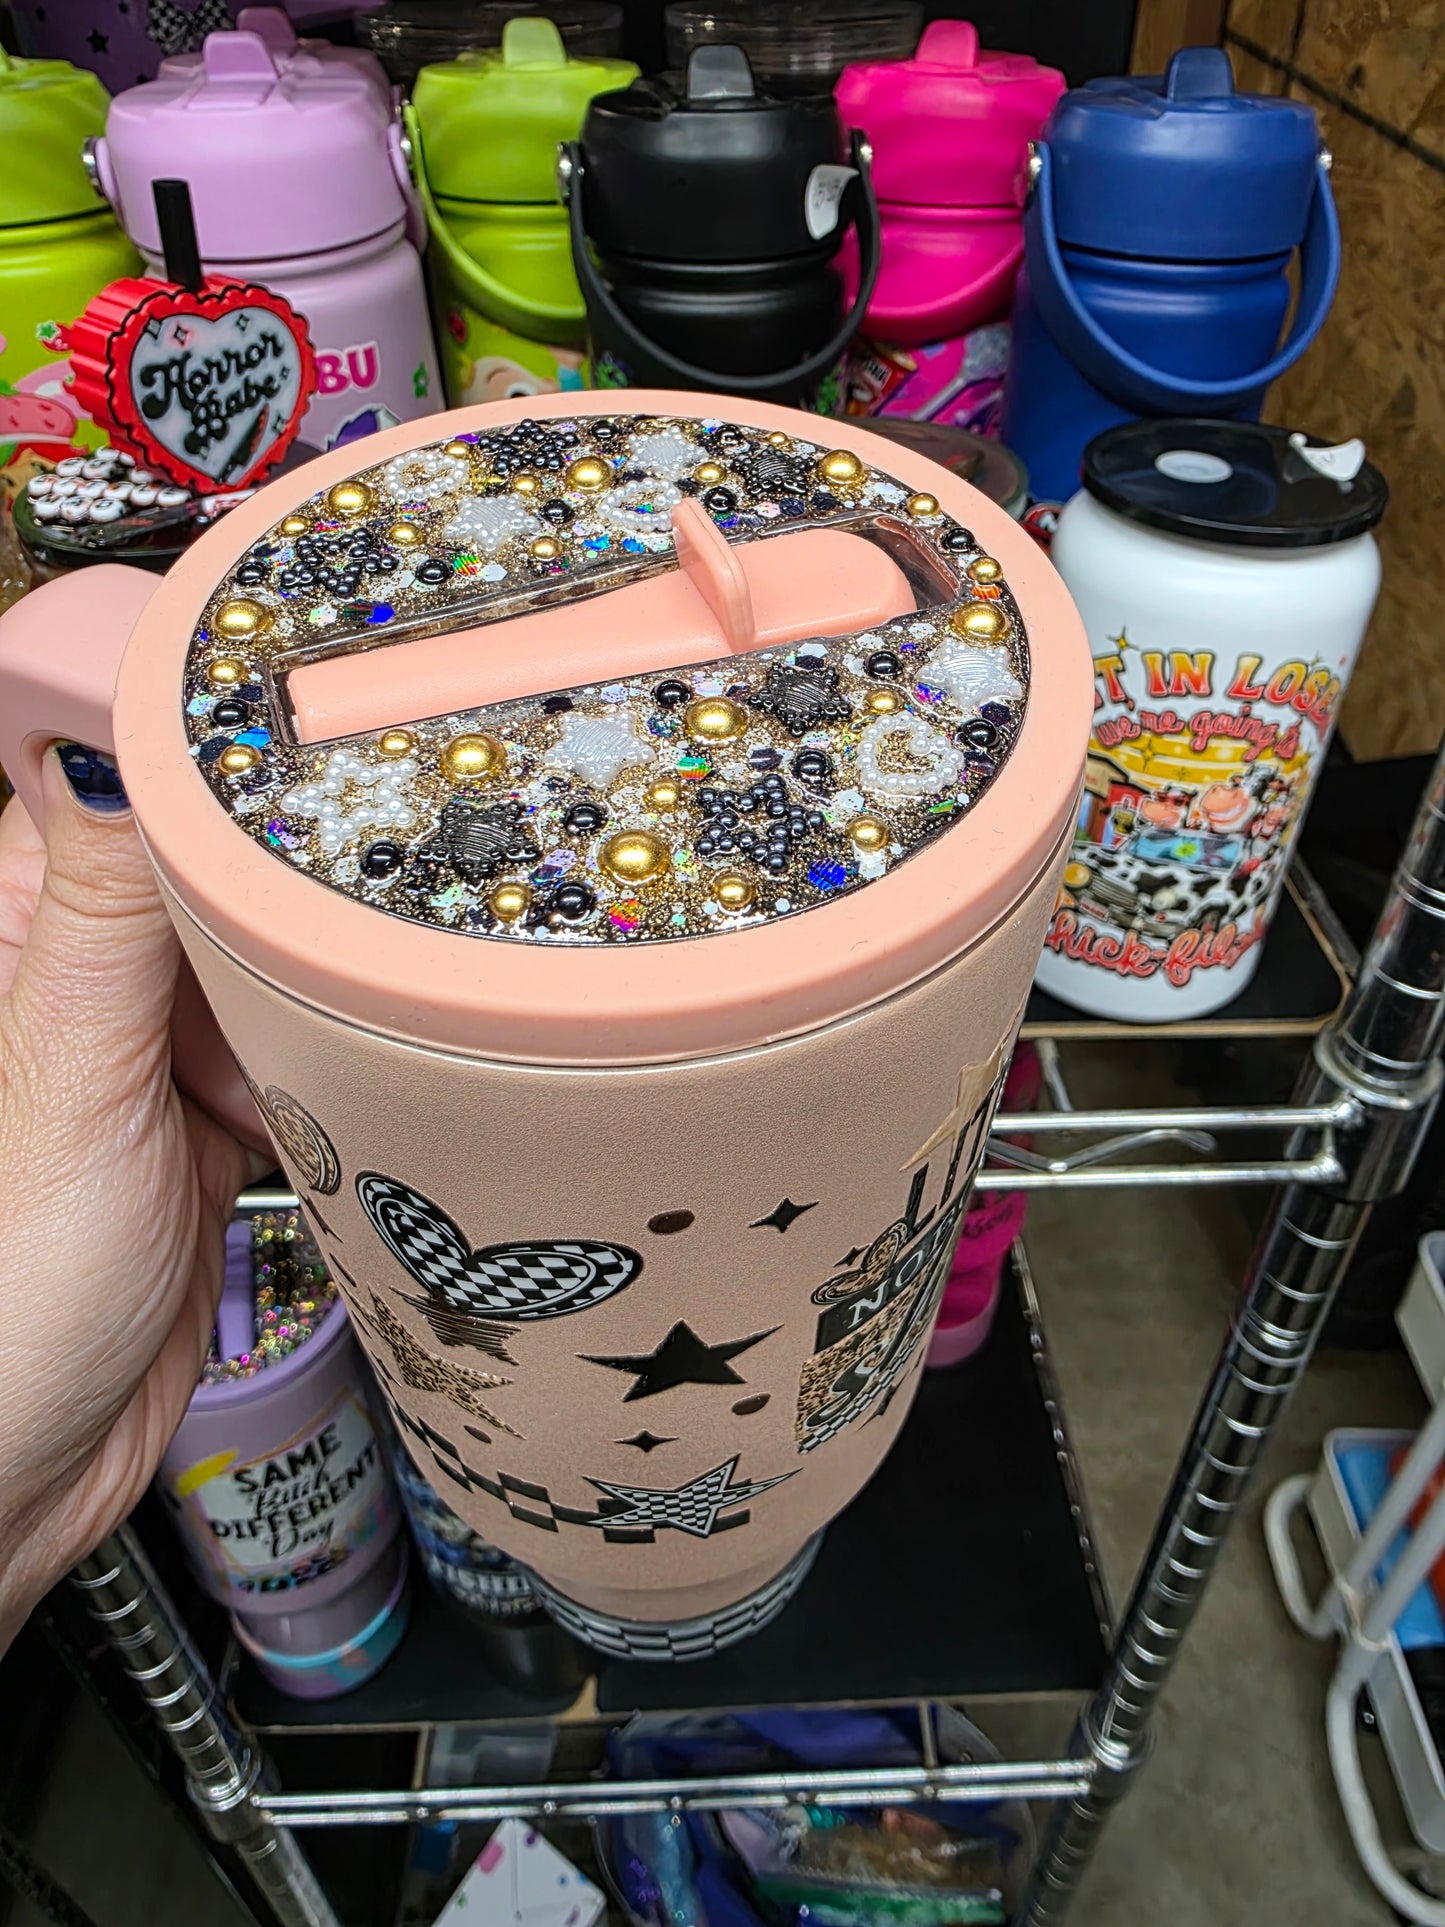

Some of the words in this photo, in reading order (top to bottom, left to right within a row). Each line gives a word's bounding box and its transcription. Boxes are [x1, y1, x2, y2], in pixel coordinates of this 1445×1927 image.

[140, 331, 283, 419] Horror
[1142, 652, 1214, 697] IN
[1190, 703, 1280, 762] going
[210, 1437, 377, 1540] DIFFERENT
[234, 1422, 342, 1494] SAME
[263, 1517, 335, 1558] Day
